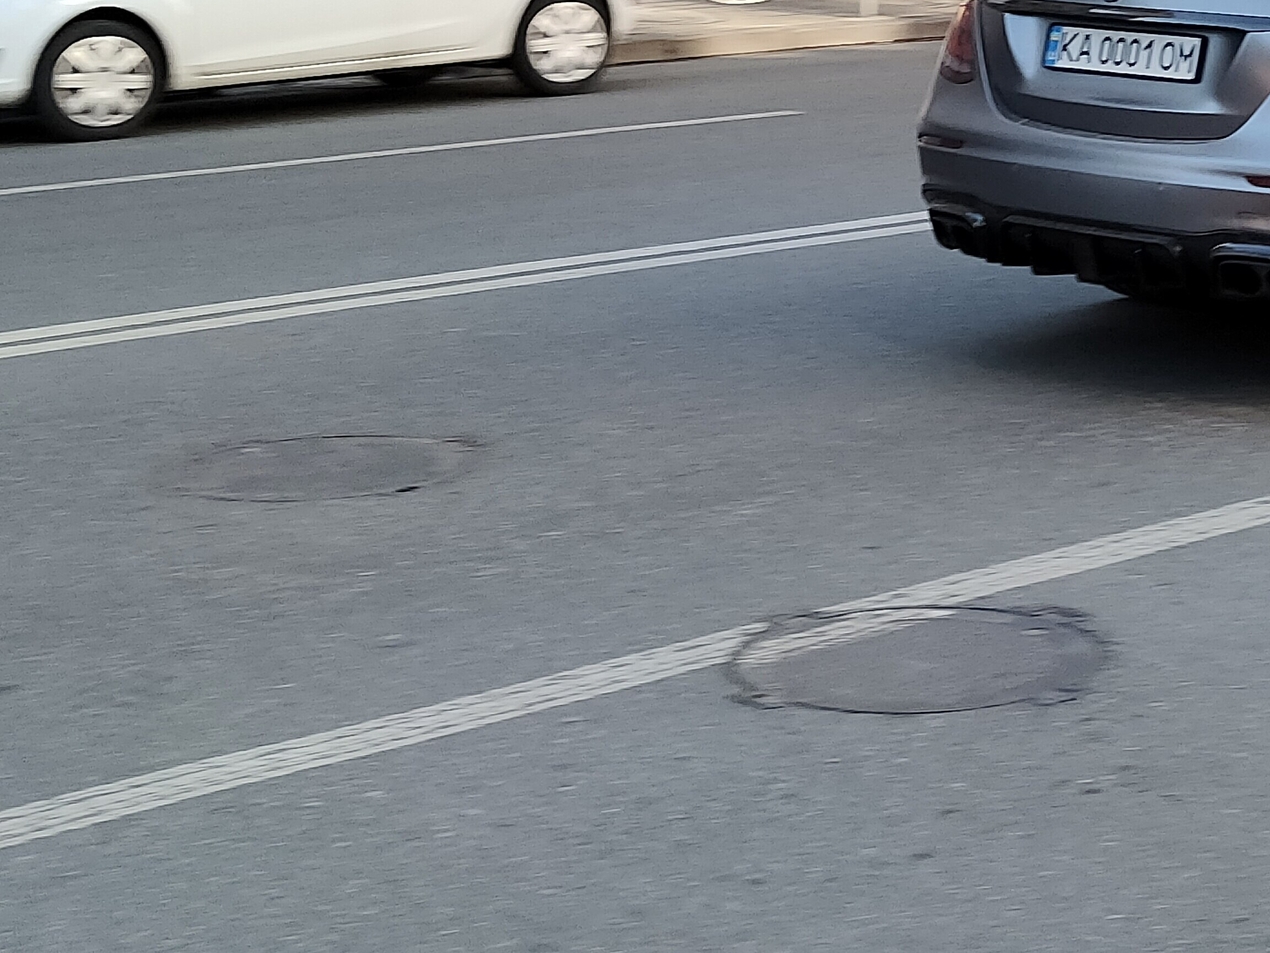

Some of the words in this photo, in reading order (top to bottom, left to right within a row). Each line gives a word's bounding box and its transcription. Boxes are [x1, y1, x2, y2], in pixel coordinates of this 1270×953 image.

[1057, 32, 1091, 63] KA
[1099, 36, 1155, 69] 0001
[1160, 41, 1196, 74] OM
